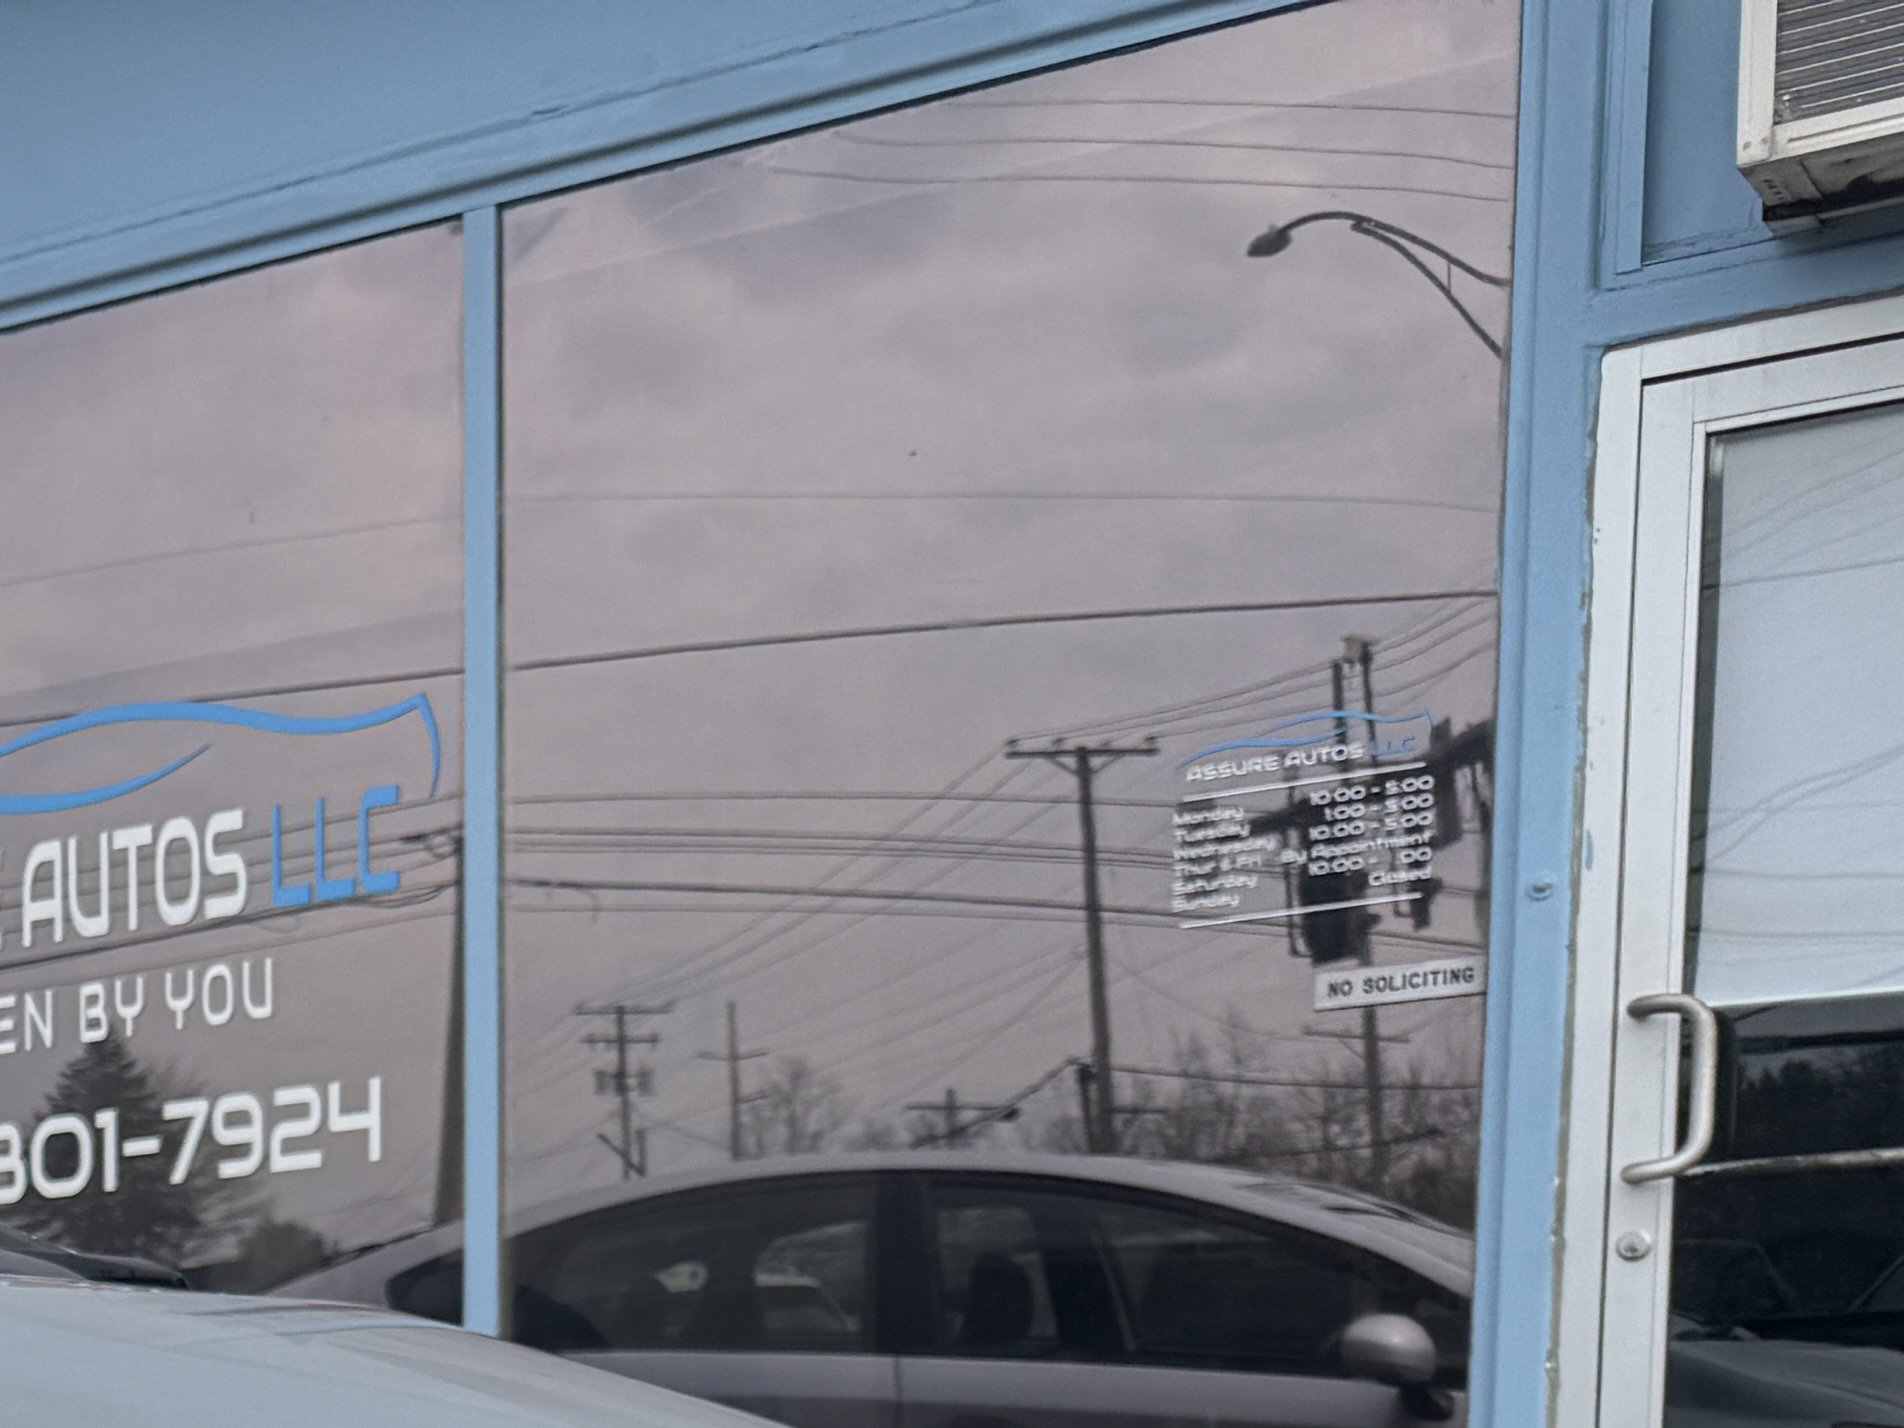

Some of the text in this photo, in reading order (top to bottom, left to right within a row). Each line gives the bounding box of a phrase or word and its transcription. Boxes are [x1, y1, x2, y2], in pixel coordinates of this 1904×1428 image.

[1186, 755, 1281, 782] ASSURE
[1283, 742, 1365, 768] AUTOS
[20, 808, 246, 948] AUTOS
[270, 785, 401, 908] LLC
[78, 975, 147, 1044] BY
[163, 958, 276, 1037] YOU
[1327, 966, 1475, 998] NO SOLICITING
